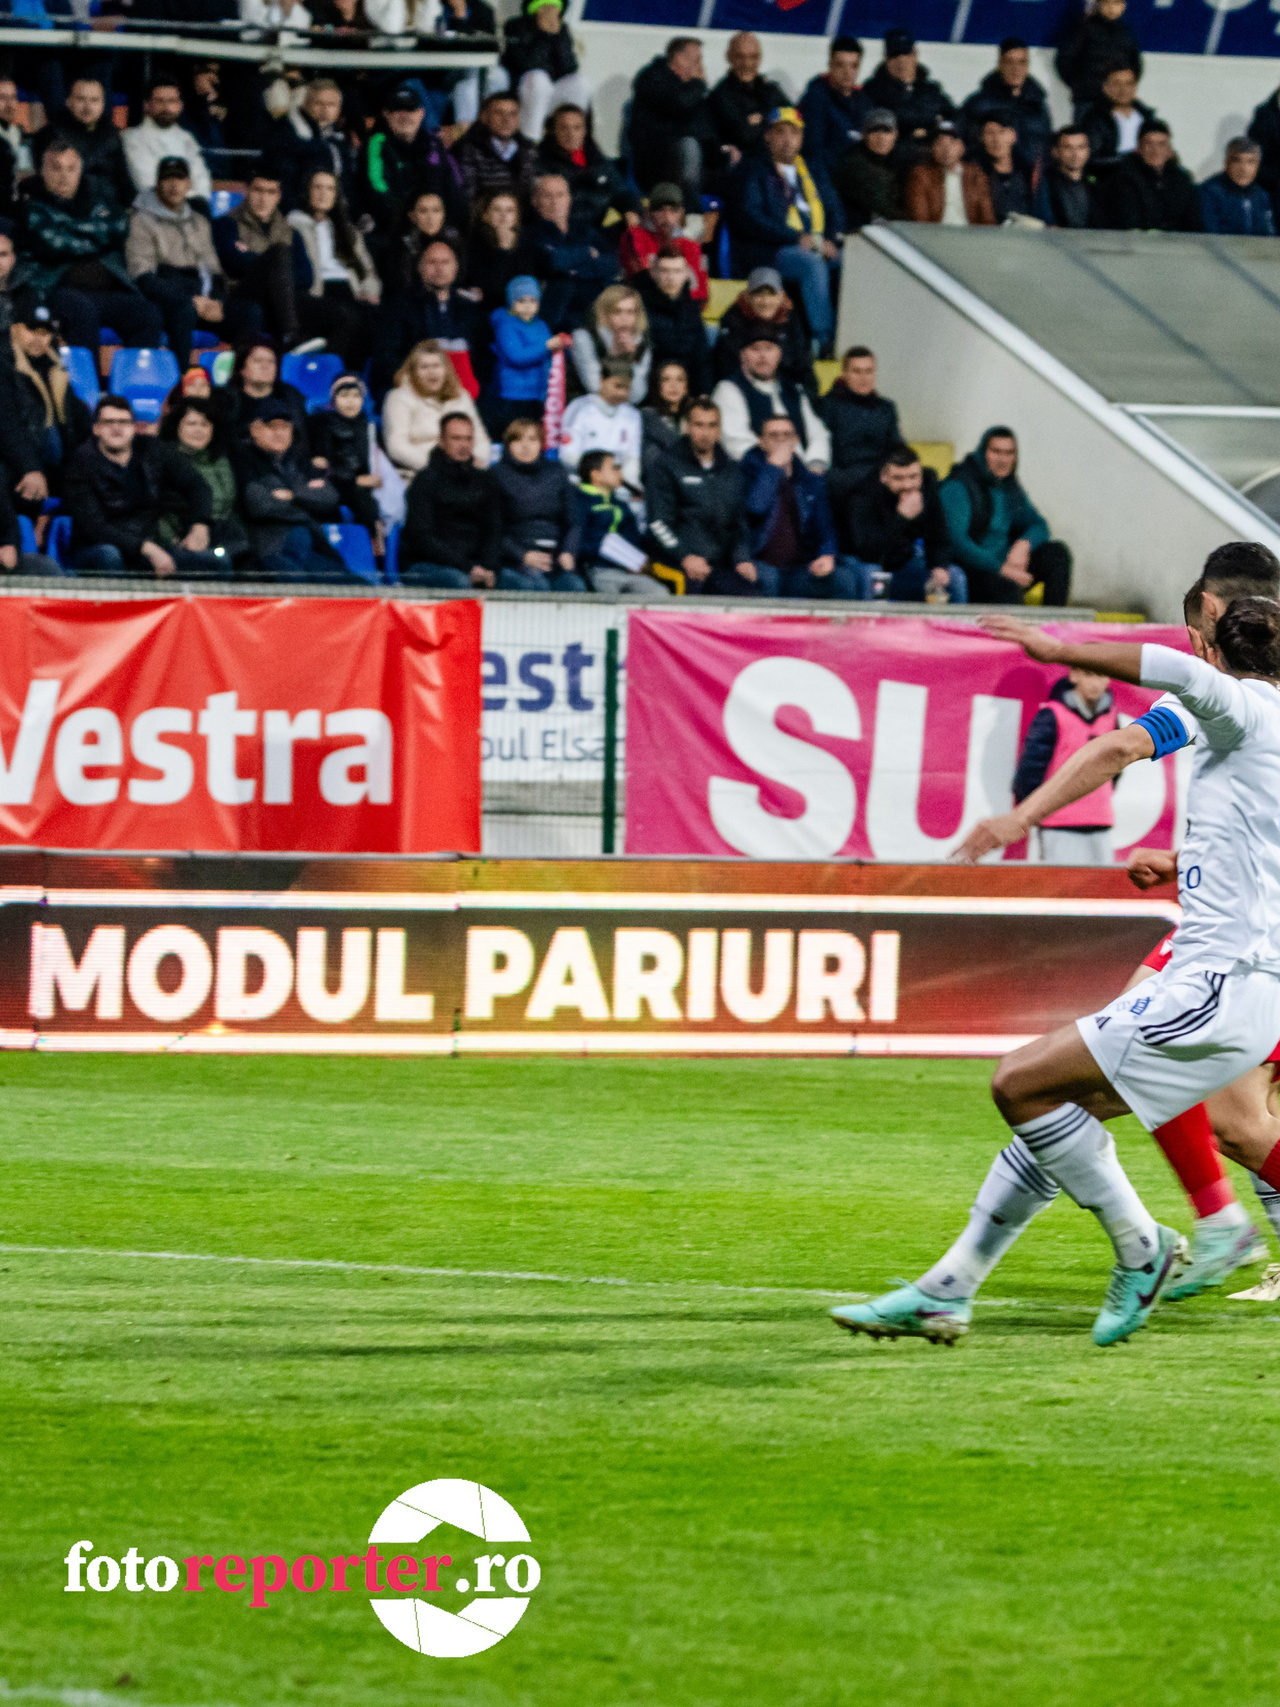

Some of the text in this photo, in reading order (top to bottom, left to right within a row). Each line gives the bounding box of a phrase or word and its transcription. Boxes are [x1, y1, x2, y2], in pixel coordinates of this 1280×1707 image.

[0, 678, 395, 806] Vestra
[30, 923, 901, 1023] MODUL PARIURI
